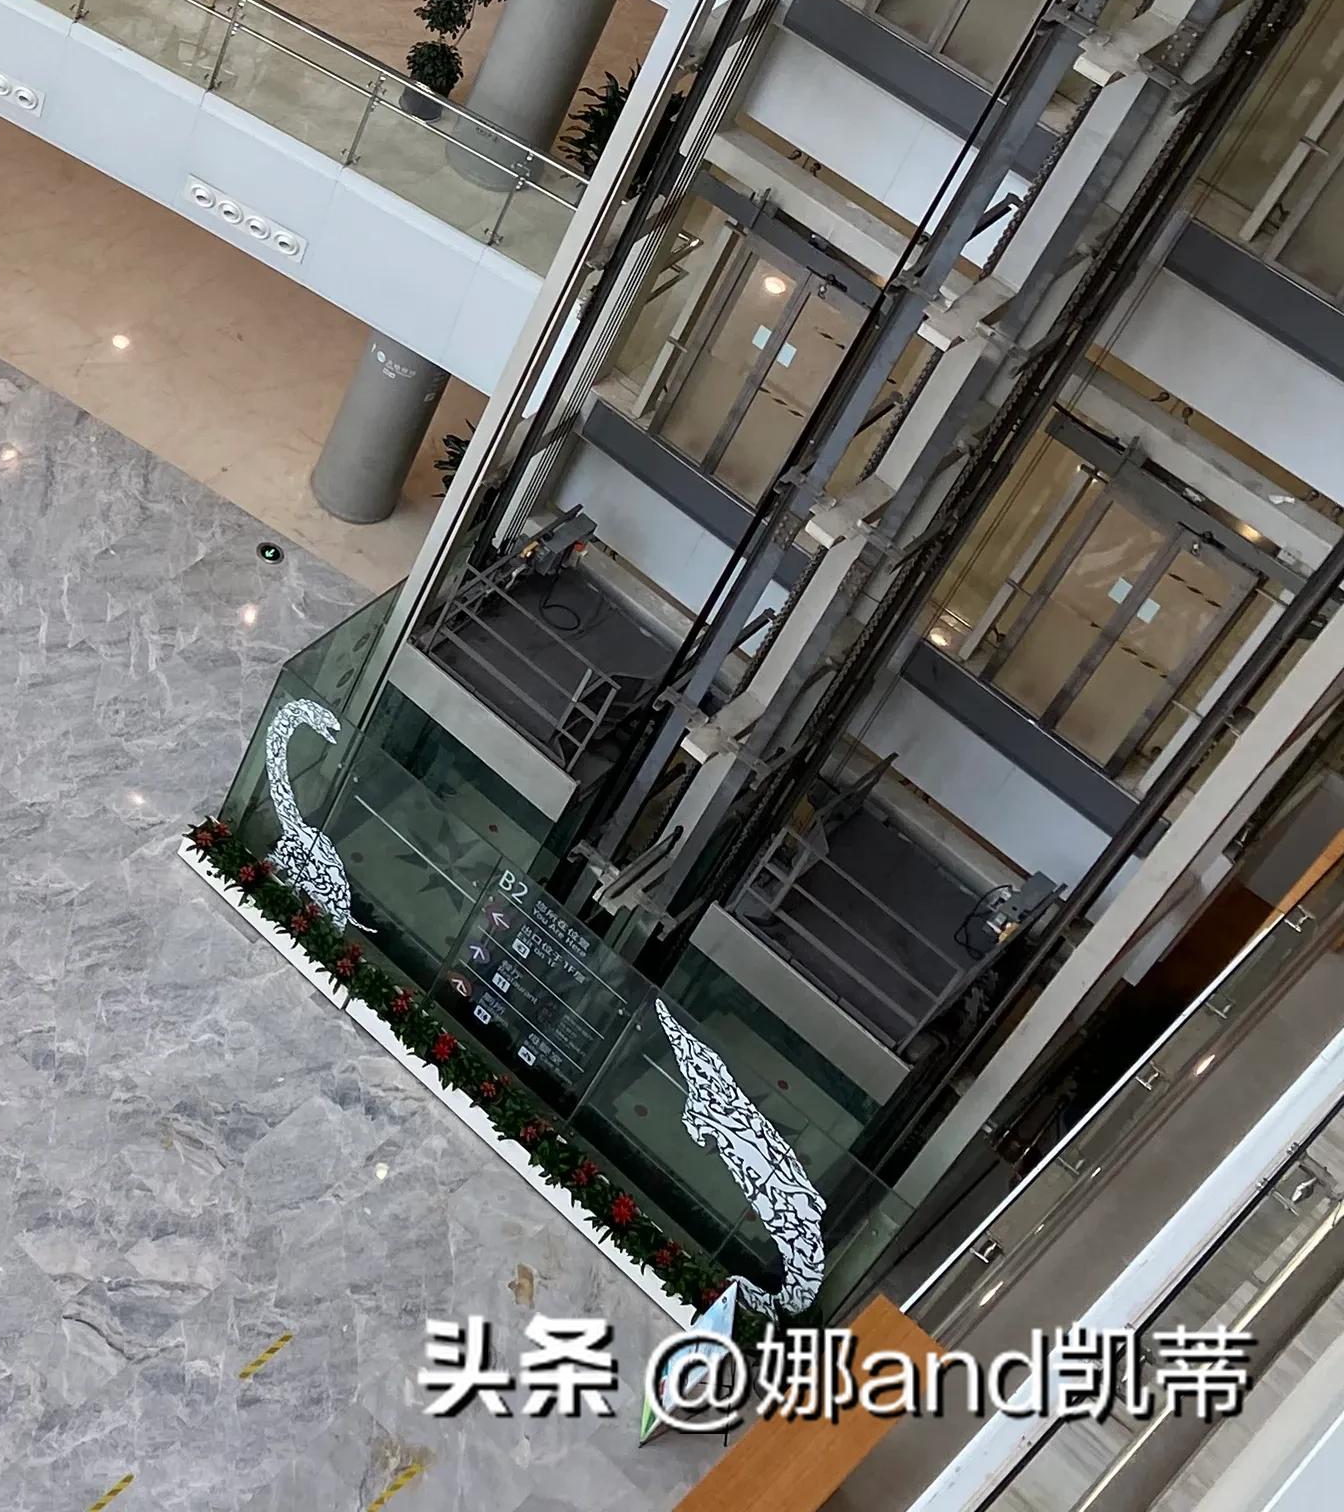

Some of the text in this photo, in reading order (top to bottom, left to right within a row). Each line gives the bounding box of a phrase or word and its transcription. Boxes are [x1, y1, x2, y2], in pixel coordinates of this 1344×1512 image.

[498, 869, 529, 905] B2
[533, 908, 587, 958] You Are Here
[534, 900, 591, 951] 您所在位置
